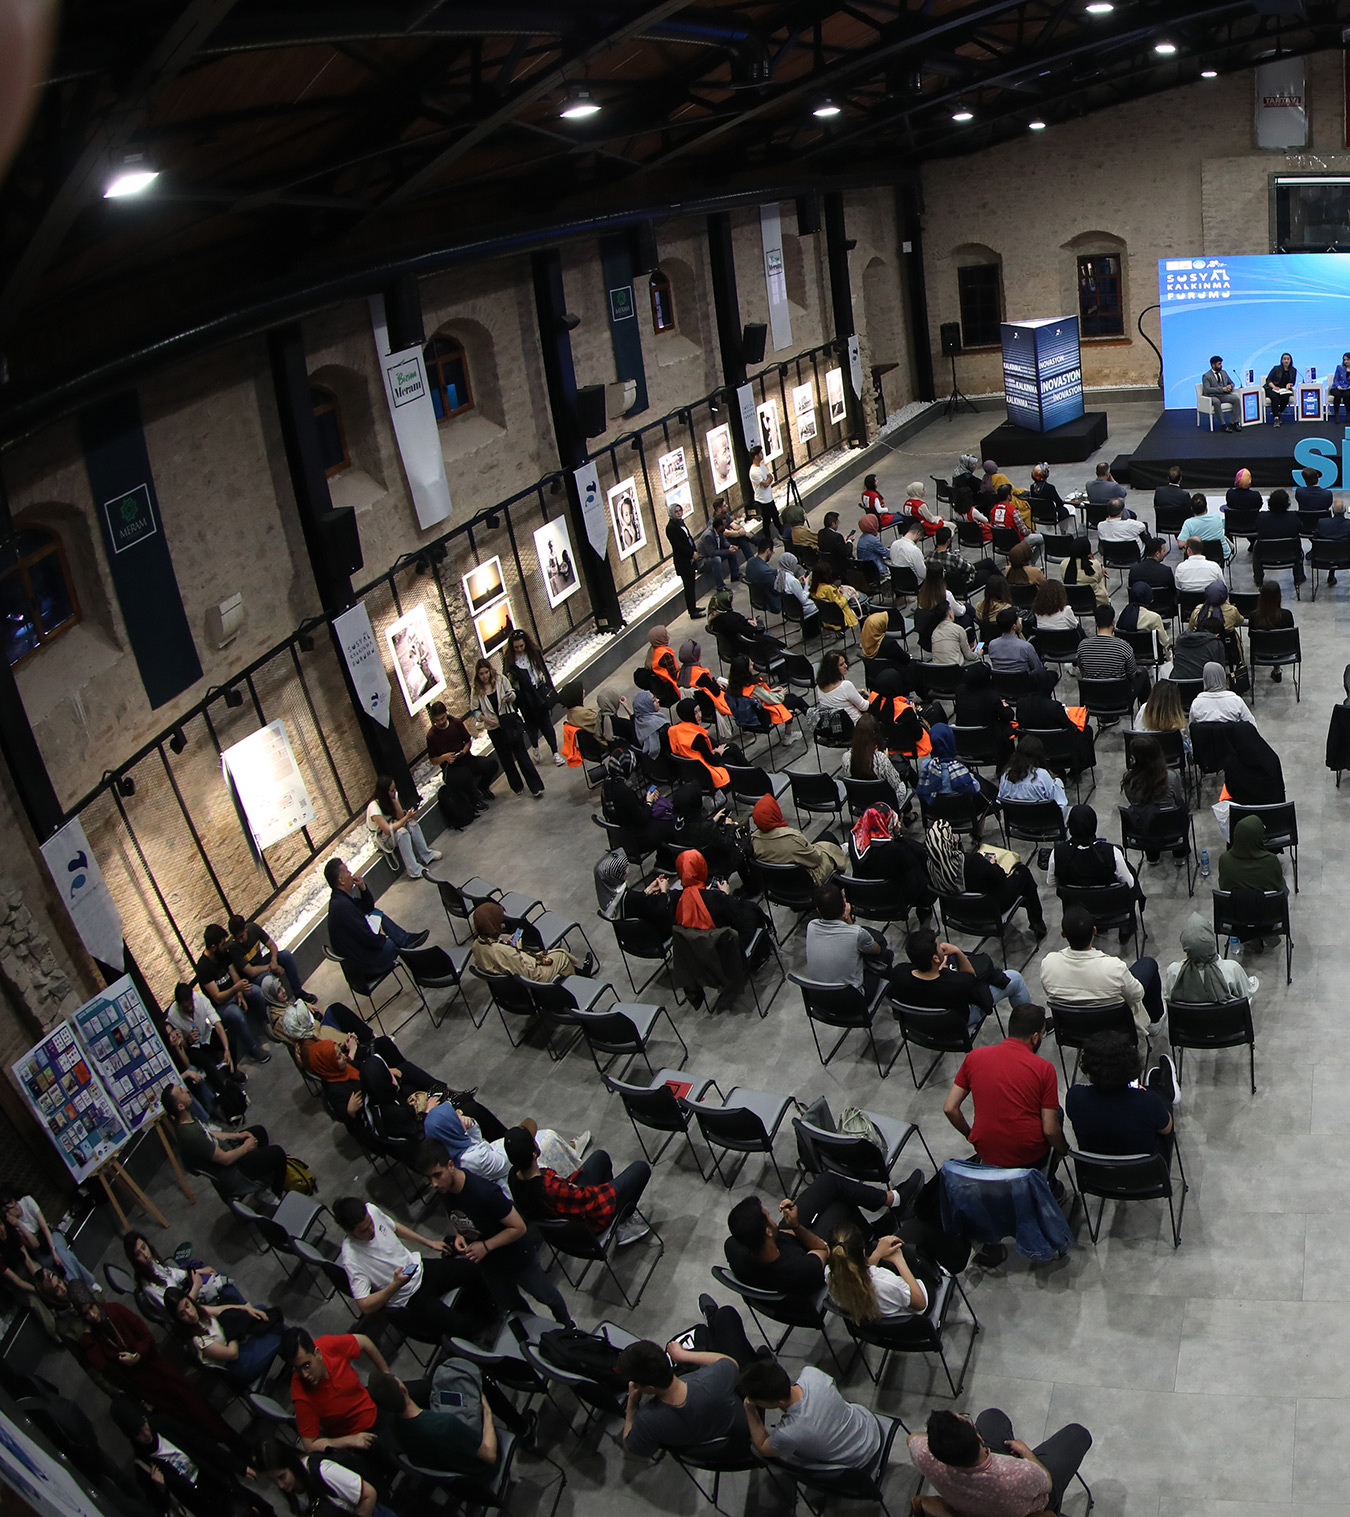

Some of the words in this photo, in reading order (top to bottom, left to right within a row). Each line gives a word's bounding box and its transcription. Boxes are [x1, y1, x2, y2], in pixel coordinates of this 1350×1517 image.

[1166, 281, 1231, 291] KALKINMA
[394, 381, 421, 399] Meram
[1040, 368, 1081, 394] İNOVASYON
[1053, 384, 1082, 402] İNOVASYON
[119, 517, 148, 539] MERAM
